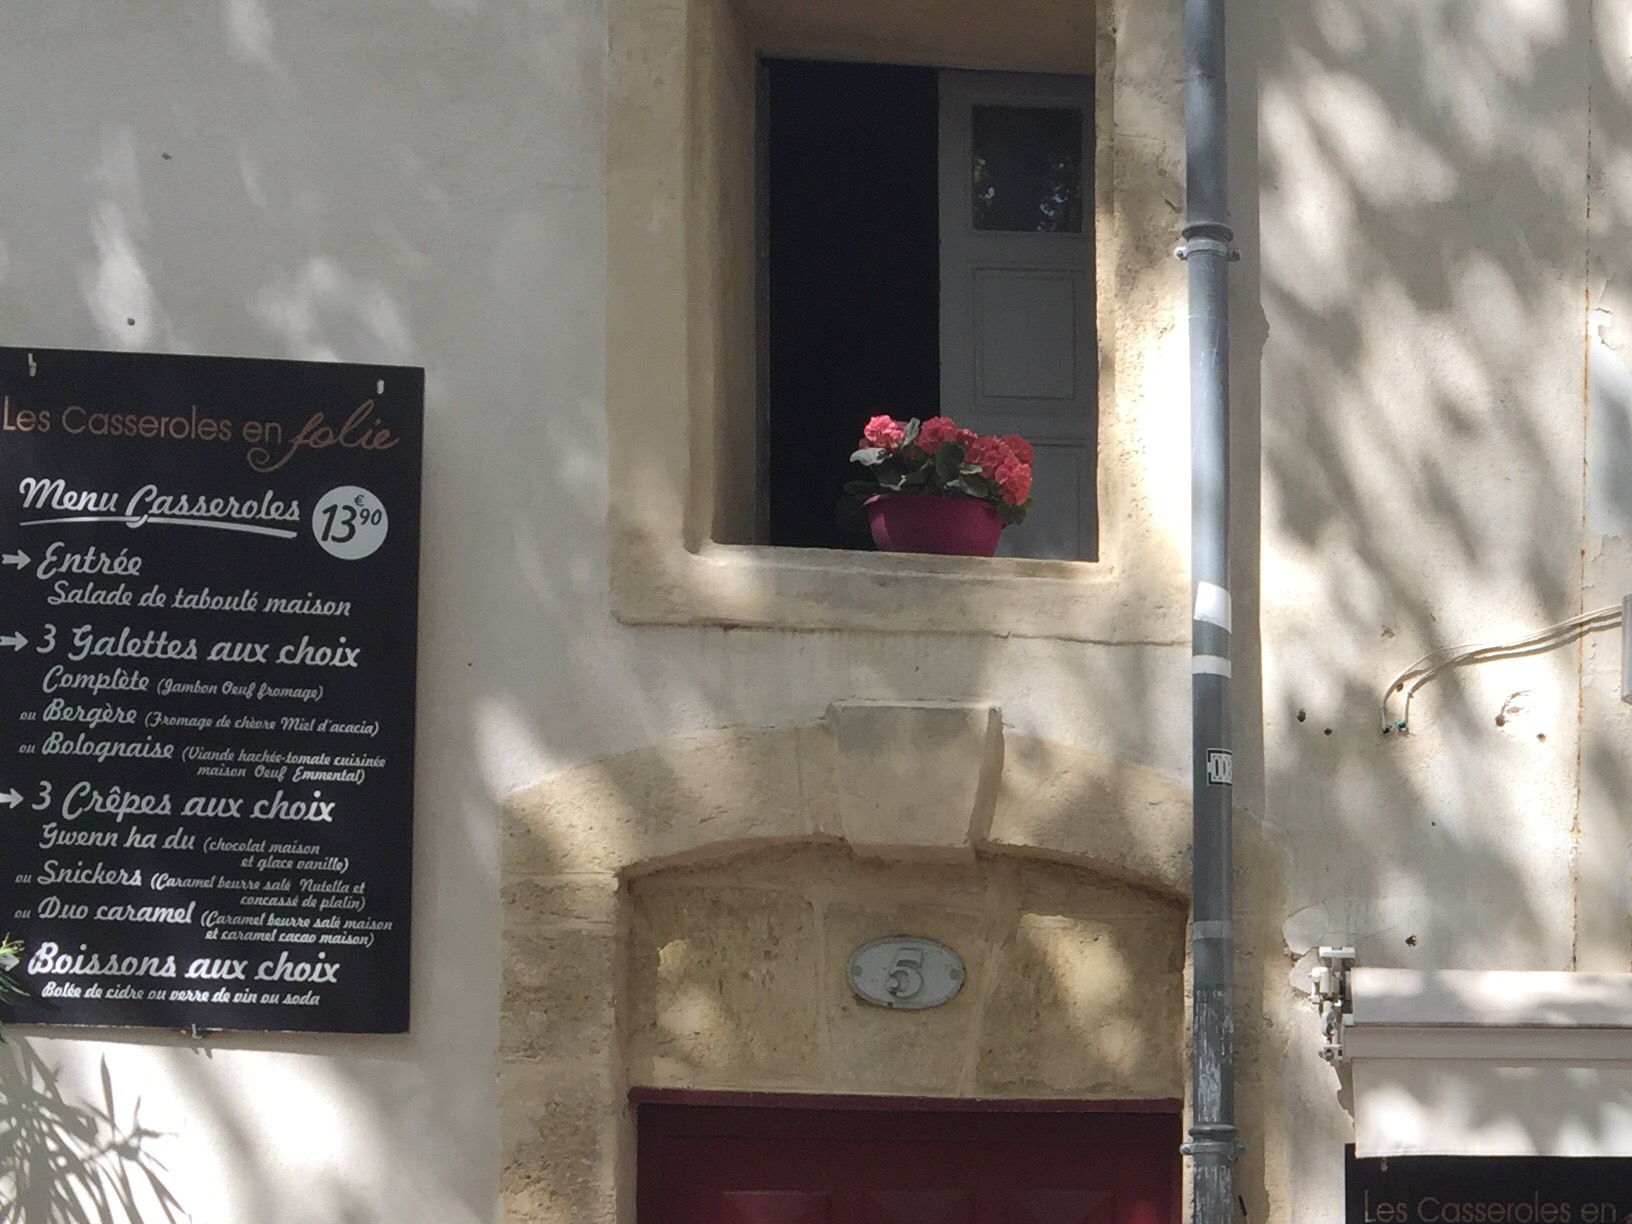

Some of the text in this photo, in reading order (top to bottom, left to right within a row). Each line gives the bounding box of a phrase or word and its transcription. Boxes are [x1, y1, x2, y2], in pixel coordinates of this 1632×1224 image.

[2, 396, 399, 472] Les Casseroles en folie
[19, 478, 300, 528] Menu Casseroles
[37, 541, 142, 580] Entrée
[47, 581, 351, 617] Salade de taboulé maison
[36, 624, 360, 667] 3 Galettes aux choix
[42, 665, 150, 695] Complète
[157, 677, 217, 696] (Jambon
[257, 682, 324, 702] fromage)
[20, 710, 36, 721] ou
[42, 698, 138, 728] Bergère
[144, 711, 213, 730] (Fromage
[215, 714, 231, 728] de
[234, 715, 276, 730] chèvre
[281, 716, 315, 732] Miel
[19, 743, 36, 753] ou
[41, 732, 174, 763] Bolognaise
[182, 745, 235, 763] (Viande
[197, 763, 246, 777] maison
[292, 766, 366, 785] Emmental)
[32, 780, 335, 822] 3 Crêpes aux choix
[39, 822, 320, 855] Gwenn ha du (chocolat maison
[15, 860, 366, 894] ou Snickers (Caramel beurre salé Nutella et
[240, 854, 349, 874] et glace vanille)
[14, 895, 393, 931] ou Duo caramel (Caramel beurre salé maison
[240, 894, 316, 909] concassé de
[205, 928, 375, 949] et caramel cacao maison)
[28, 942, 340, 983] Boissons aux choix
[886, 948, 924, 1000] 5
[41, 980, 320, 1007] Bolée de cidre ou verre de vin ou soda
[1365, 1190, 1408, 1223] Les
[1417, 1190, 1571, 1224] Casseroles
[1580, 1202, 1617, 1223] en
